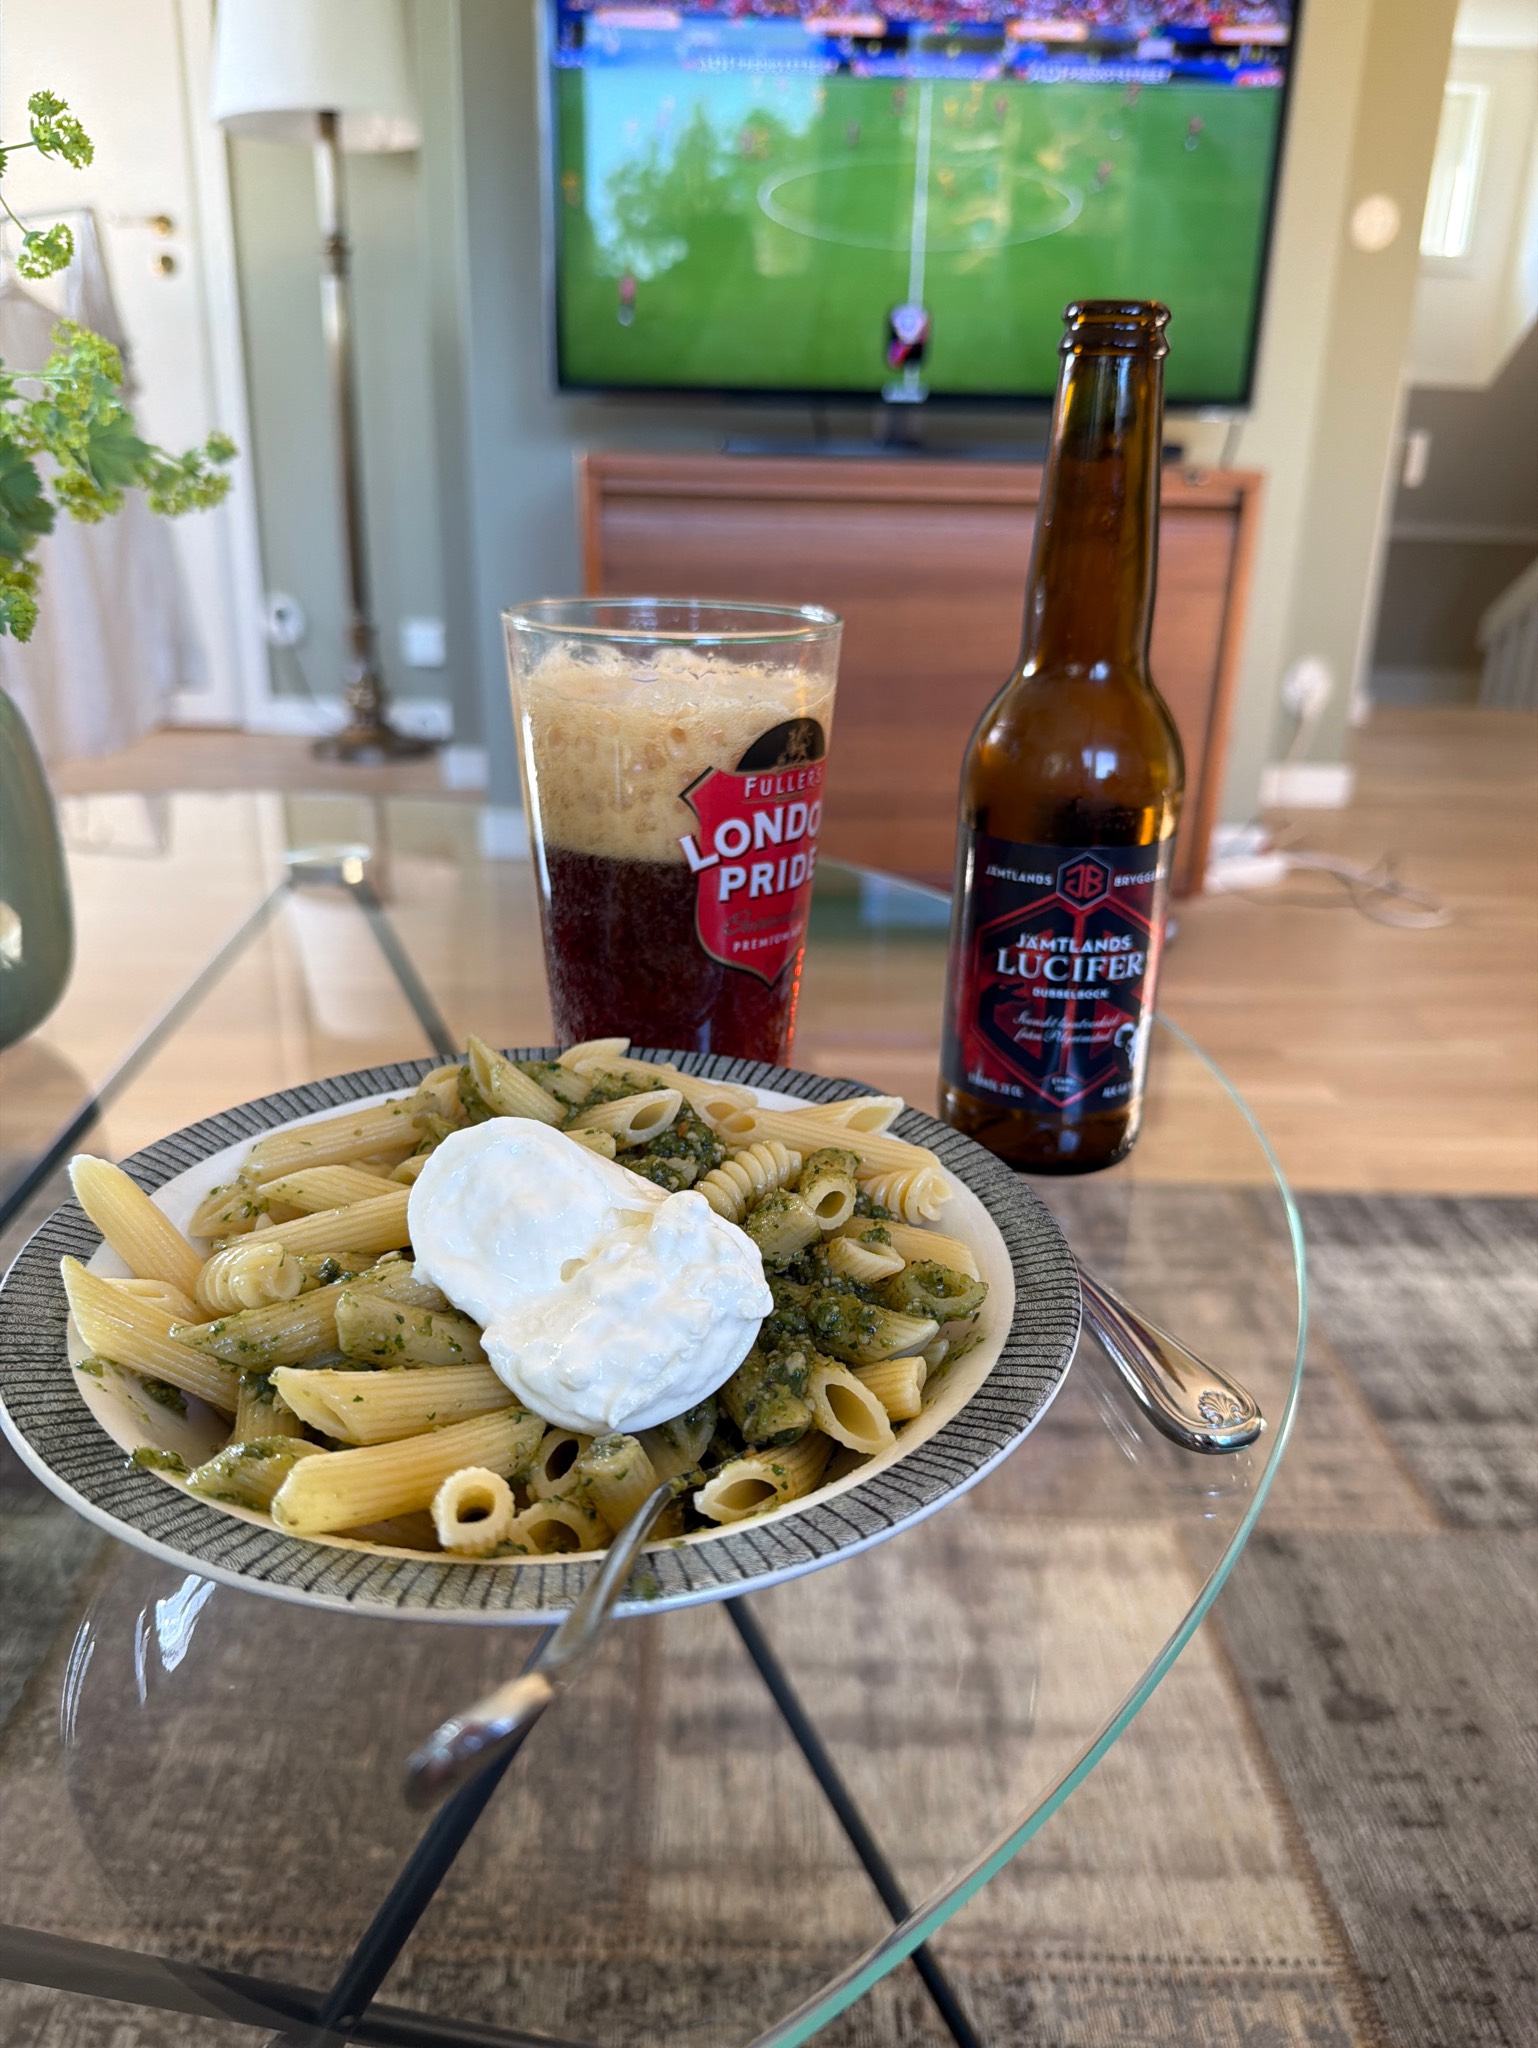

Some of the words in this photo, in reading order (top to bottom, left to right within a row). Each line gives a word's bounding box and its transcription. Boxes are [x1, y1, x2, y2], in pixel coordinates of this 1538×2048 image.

[679, 801, 822, 873] LONDO
[718, 846, 817, 901] PRIDE
[996, 948, 1147, 983] LUCIFER
[1016, 932, 1135, 954] JÄMTLANDS
